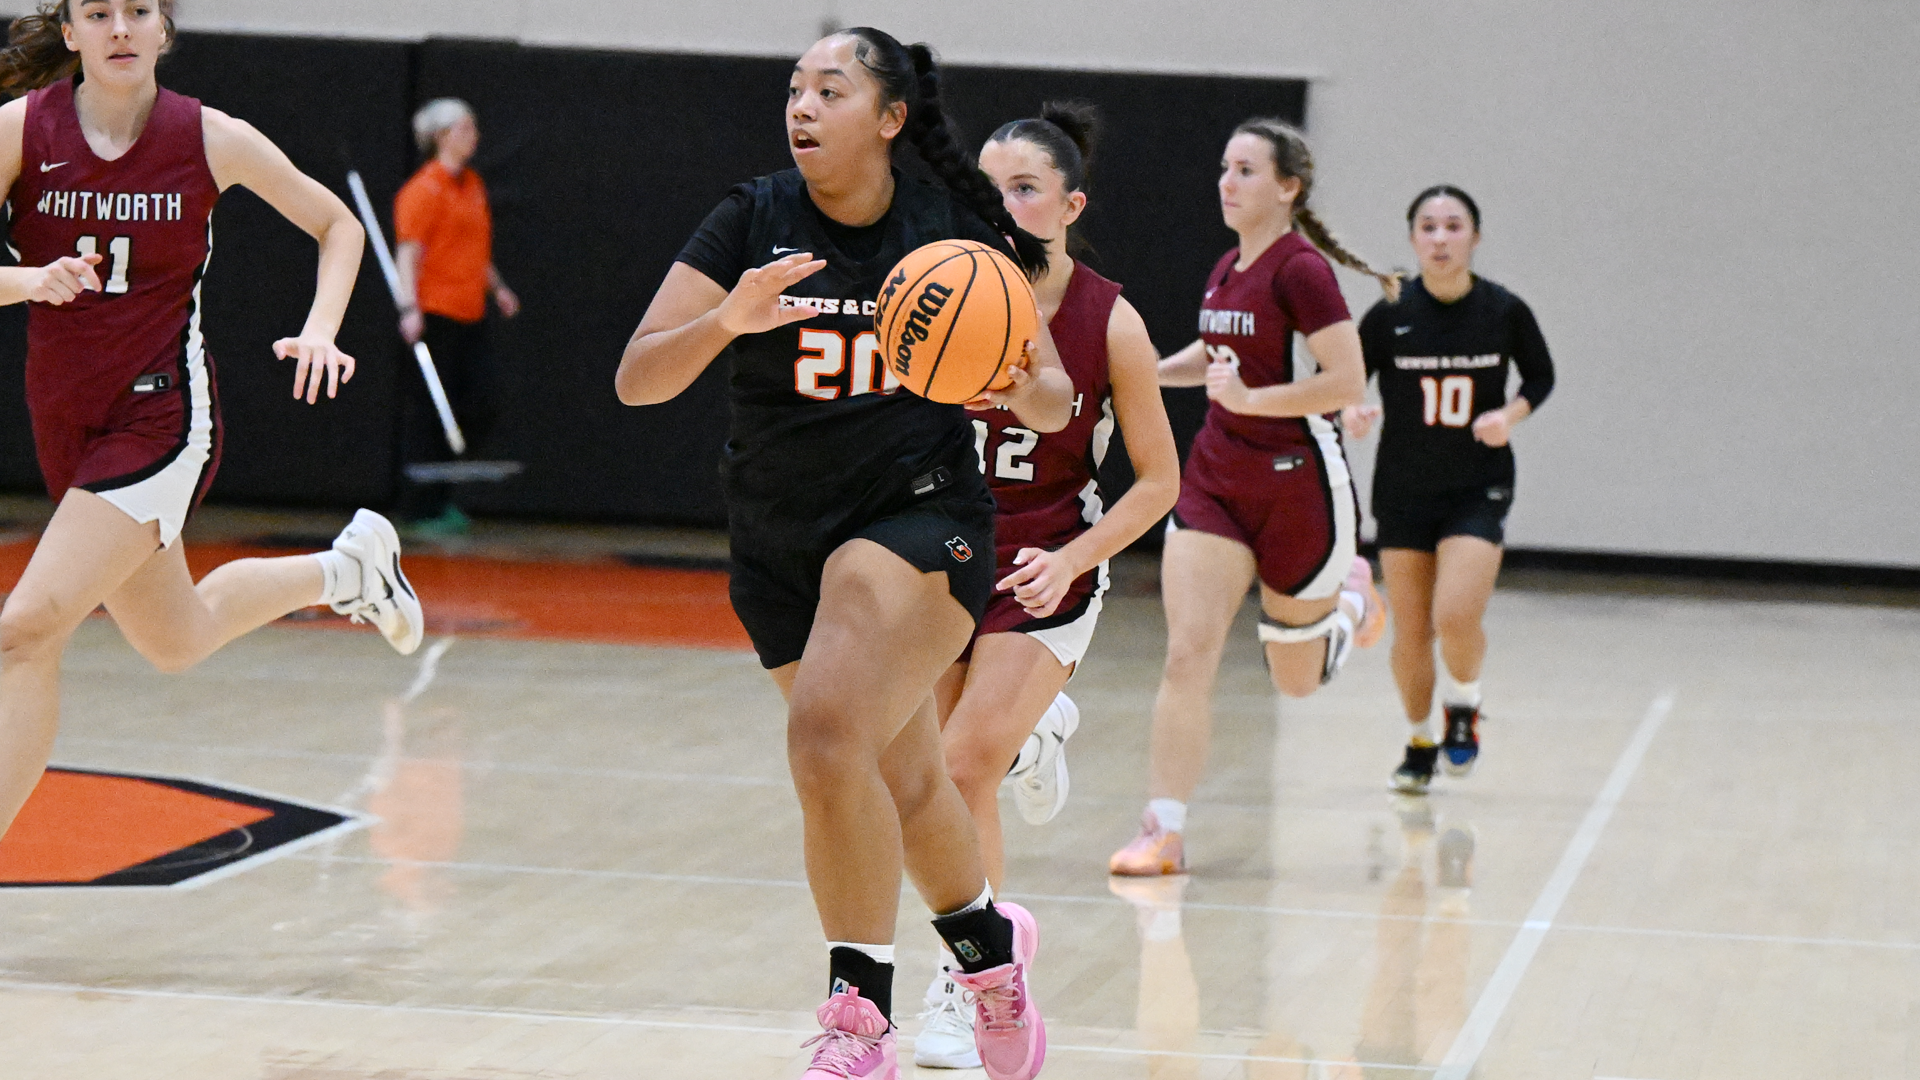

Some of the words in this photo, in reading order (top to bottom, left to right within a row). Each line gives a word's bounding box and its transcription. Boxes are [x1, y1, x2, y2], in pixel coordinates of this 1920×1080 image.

[37, 190, 182, 221] WHITWORTH
[778, 294, 840, 315] EWIS
[842, 299, 860, 315] &
[895, 282, 955, 377] Wilson
[1420, 375, 1475, 428] 10
[970, 418, 1040, 482] 12
